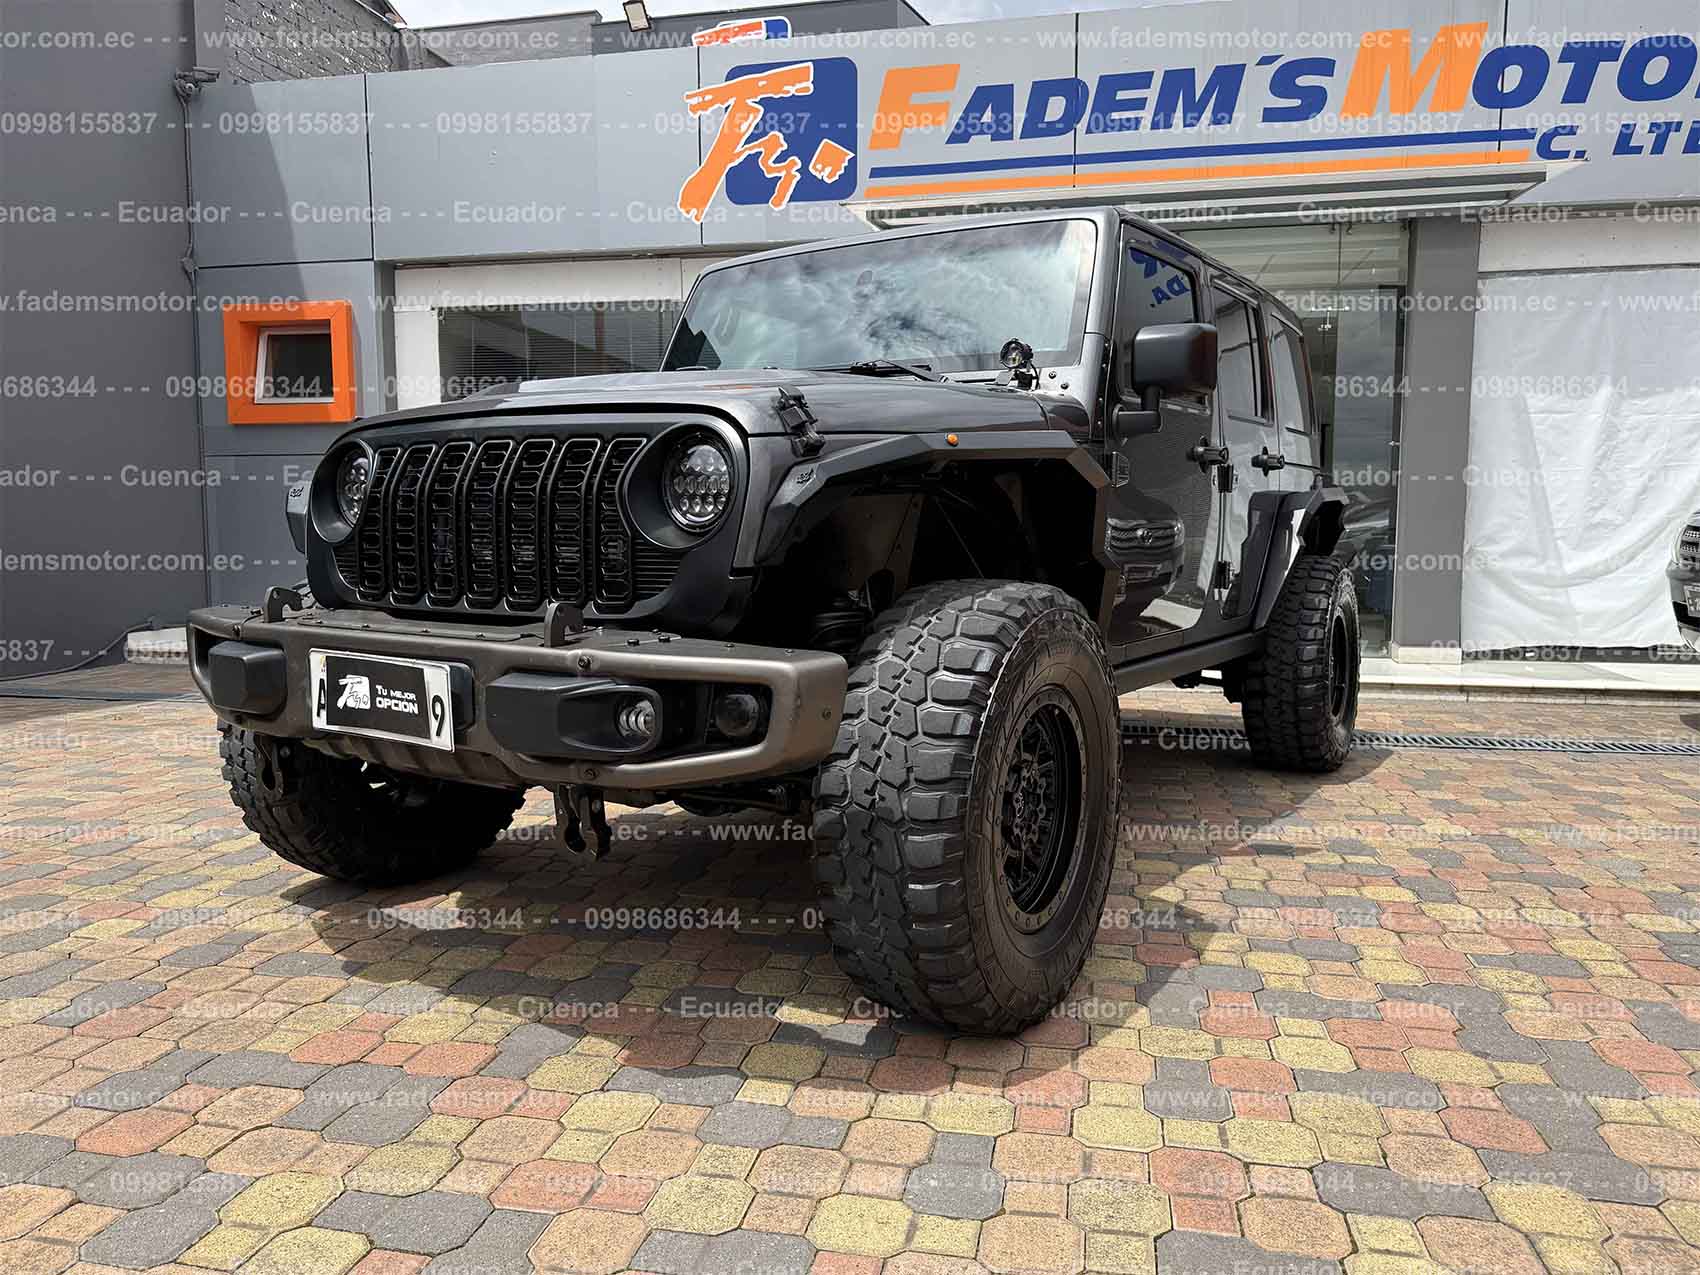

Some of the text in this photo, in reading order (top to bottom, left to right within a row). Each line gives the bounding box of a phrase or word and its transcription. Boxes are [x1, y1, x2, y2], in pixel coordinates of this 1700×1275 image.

[1341, 22, 1700, 119] MOTO
[1536, 124, 1587, 161] C.
[390, 689, 417, 701] MEJOR
[432, 694, 445, 737] 9
